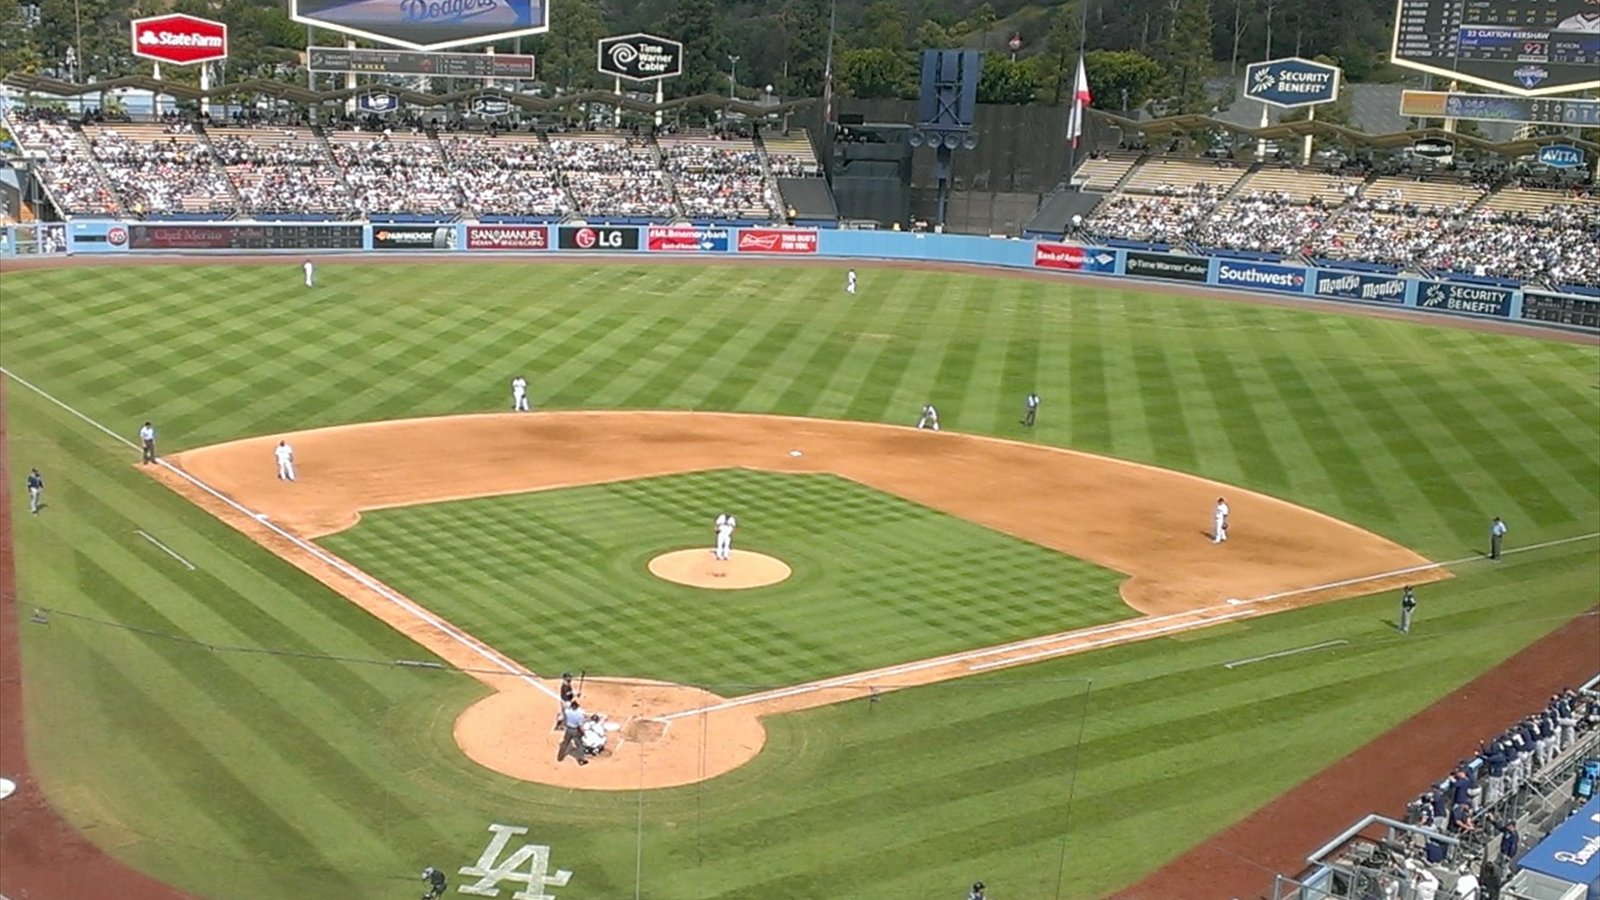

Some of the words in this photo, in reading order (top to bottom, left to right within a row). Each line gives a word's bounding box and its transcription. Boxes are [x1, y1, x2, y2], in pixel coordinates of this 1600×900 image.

[160, 31, 191, 46] State
[191, 33, 222, 46] Farm
[1478, 30, 1511, 39] CLAYTON
[1512, 31, 1550, 40] KERSHAW
[639, 43, 664, 53] Time
[1524, 43, 1541, 54] 92
[639, 52, 673, 63] Warner
[638, 61, 665, 72] Cable
[1280, 70, 1330, 83] SECURITY
[1278, 81, 1322, 94] BENEFIT
[1543, 149, 1579, 163] AVITA
[154, 229, 182, 243] Chef
[184, 229, 223, 241] Merito
[471, 229, 494, 240] SAN
[500, 230, 544, 240] MANUEL
[599, 231, 622, 247] LG
[1037, 250, 1056, 260] Bank
[1057, 253, 1065, 261] of
[1065, 253, 1095, 264] America
[1138, 259, 1156, 269] Time
[1156, 261, 1183, 271] Warner
[1183, 263, 1205, 274] Cable
[1220, 265, 1293, 286] Southwest
[1449, 286, 1506, 303] SECURITY
[1446, 297, 1497, 314] BENEFIT
[458, 823, 573, 900] LA
